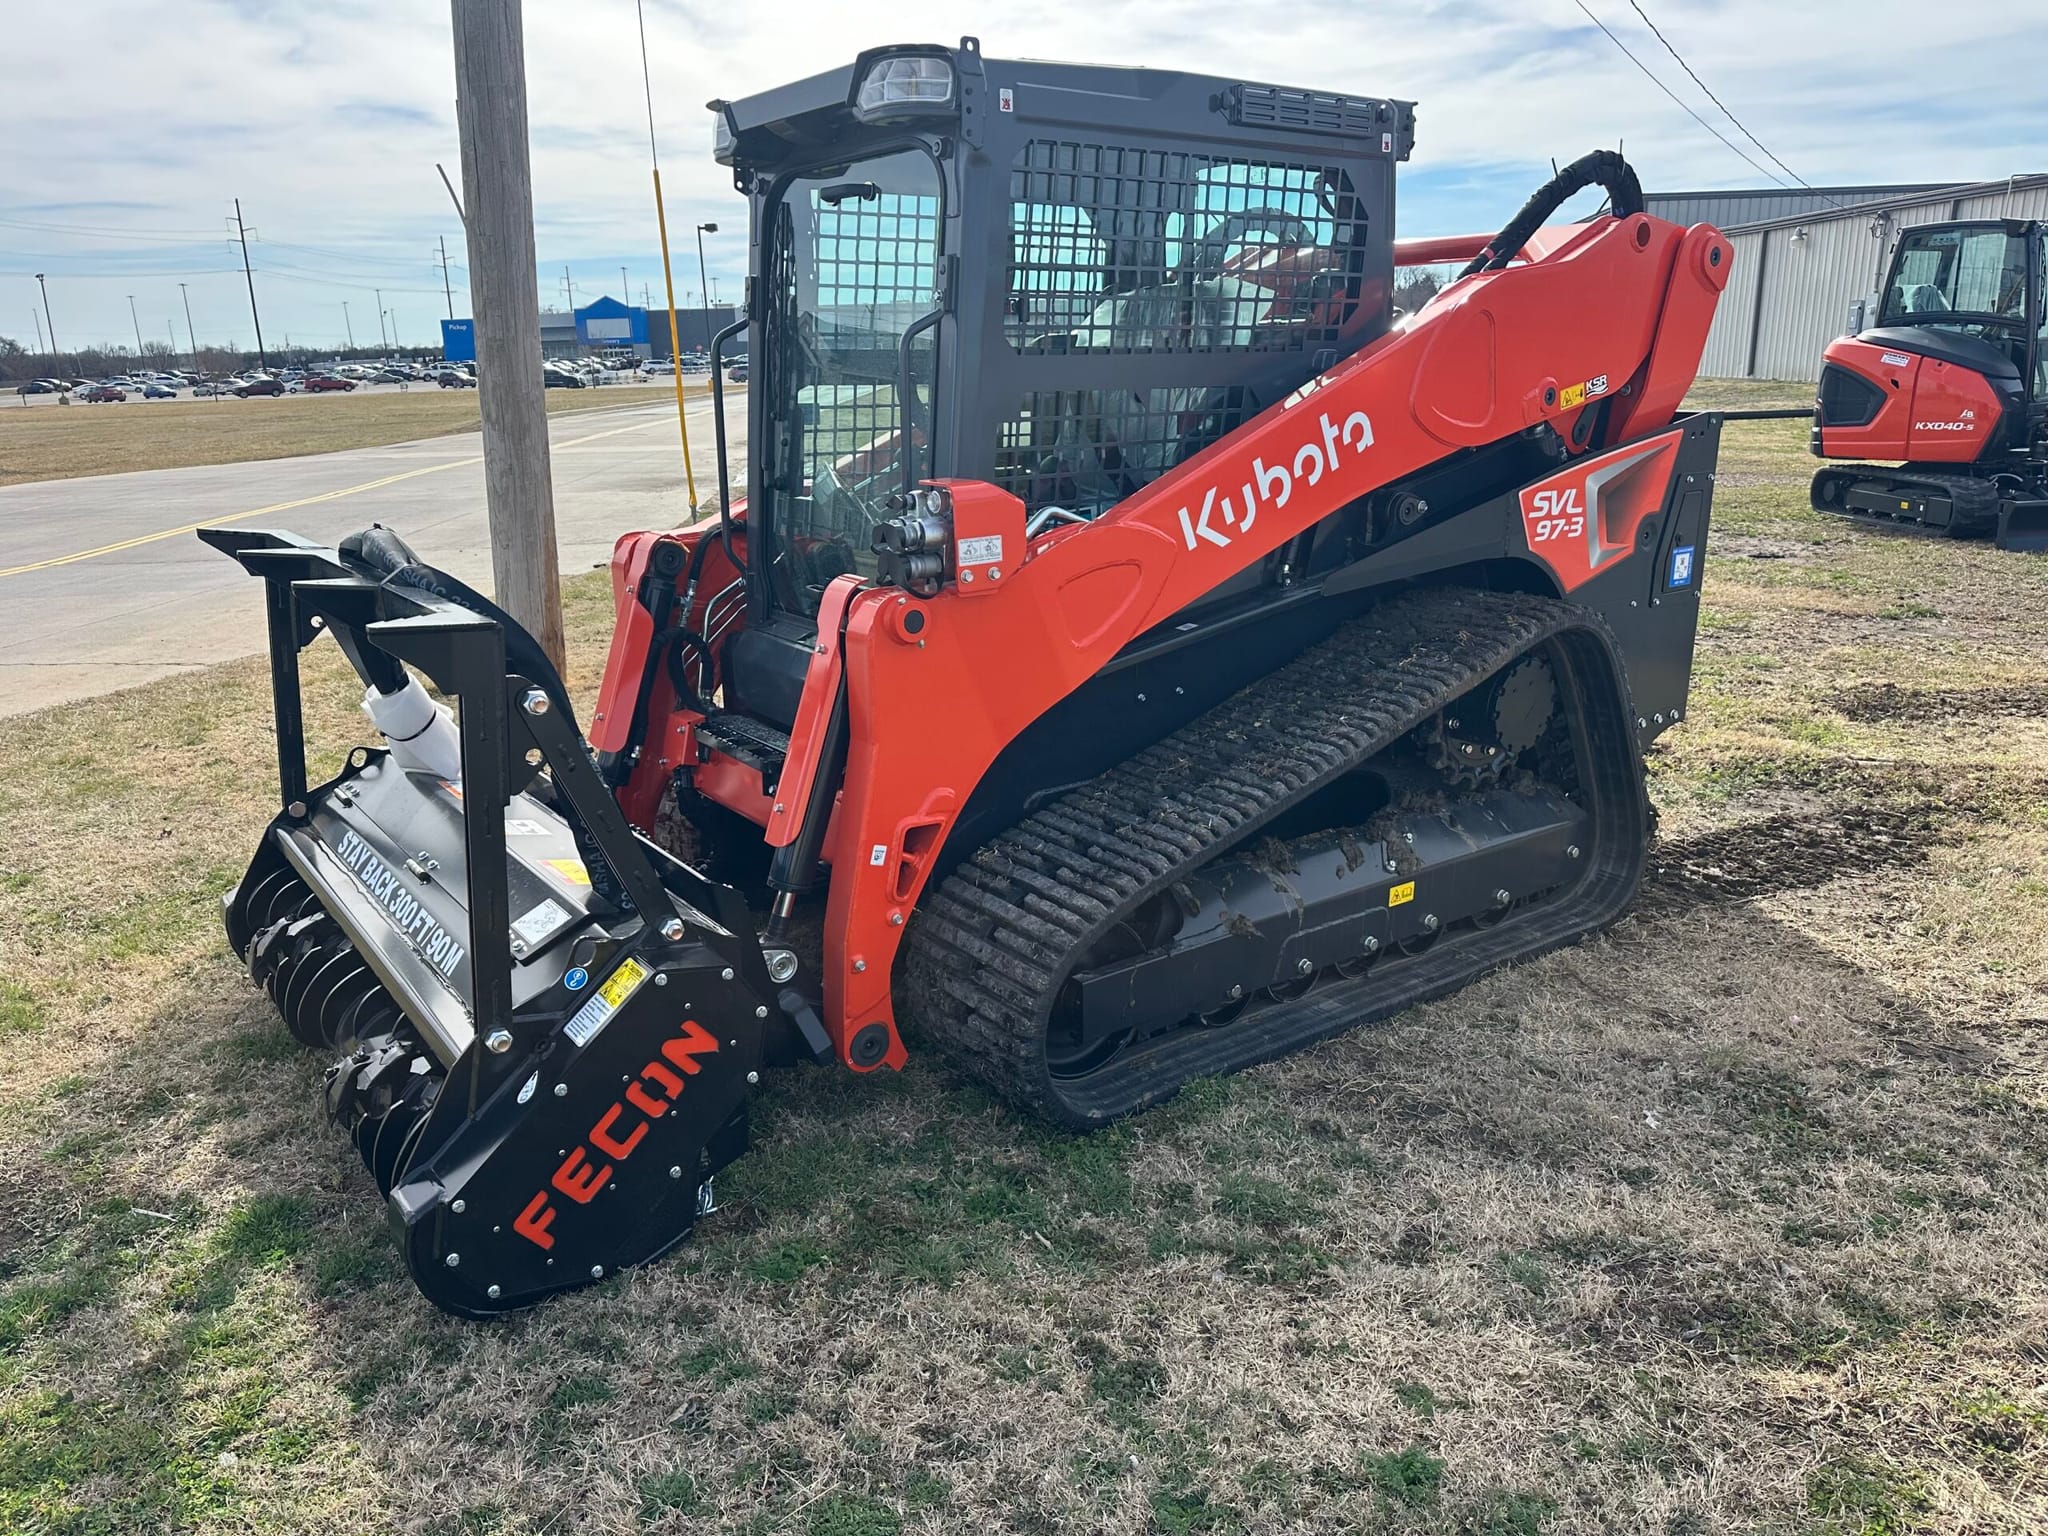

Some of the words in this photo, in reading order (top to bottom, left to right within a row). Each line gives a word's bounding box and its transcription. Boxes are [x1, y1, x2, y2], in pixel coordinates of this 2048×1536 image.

[1585, 375, 1608, 391] KSR
[1177, 411, 1375, 551] Kubota
[1528, 488, 1583, 518] SVL
[1534, 516, 1584, 542] 97-3
[337, 830, 371, 872] STAY
[360, 856, 400, 906] BACK
[389, 887, 419, 929] 300
[513, 1020, 720, 1251] FECON
